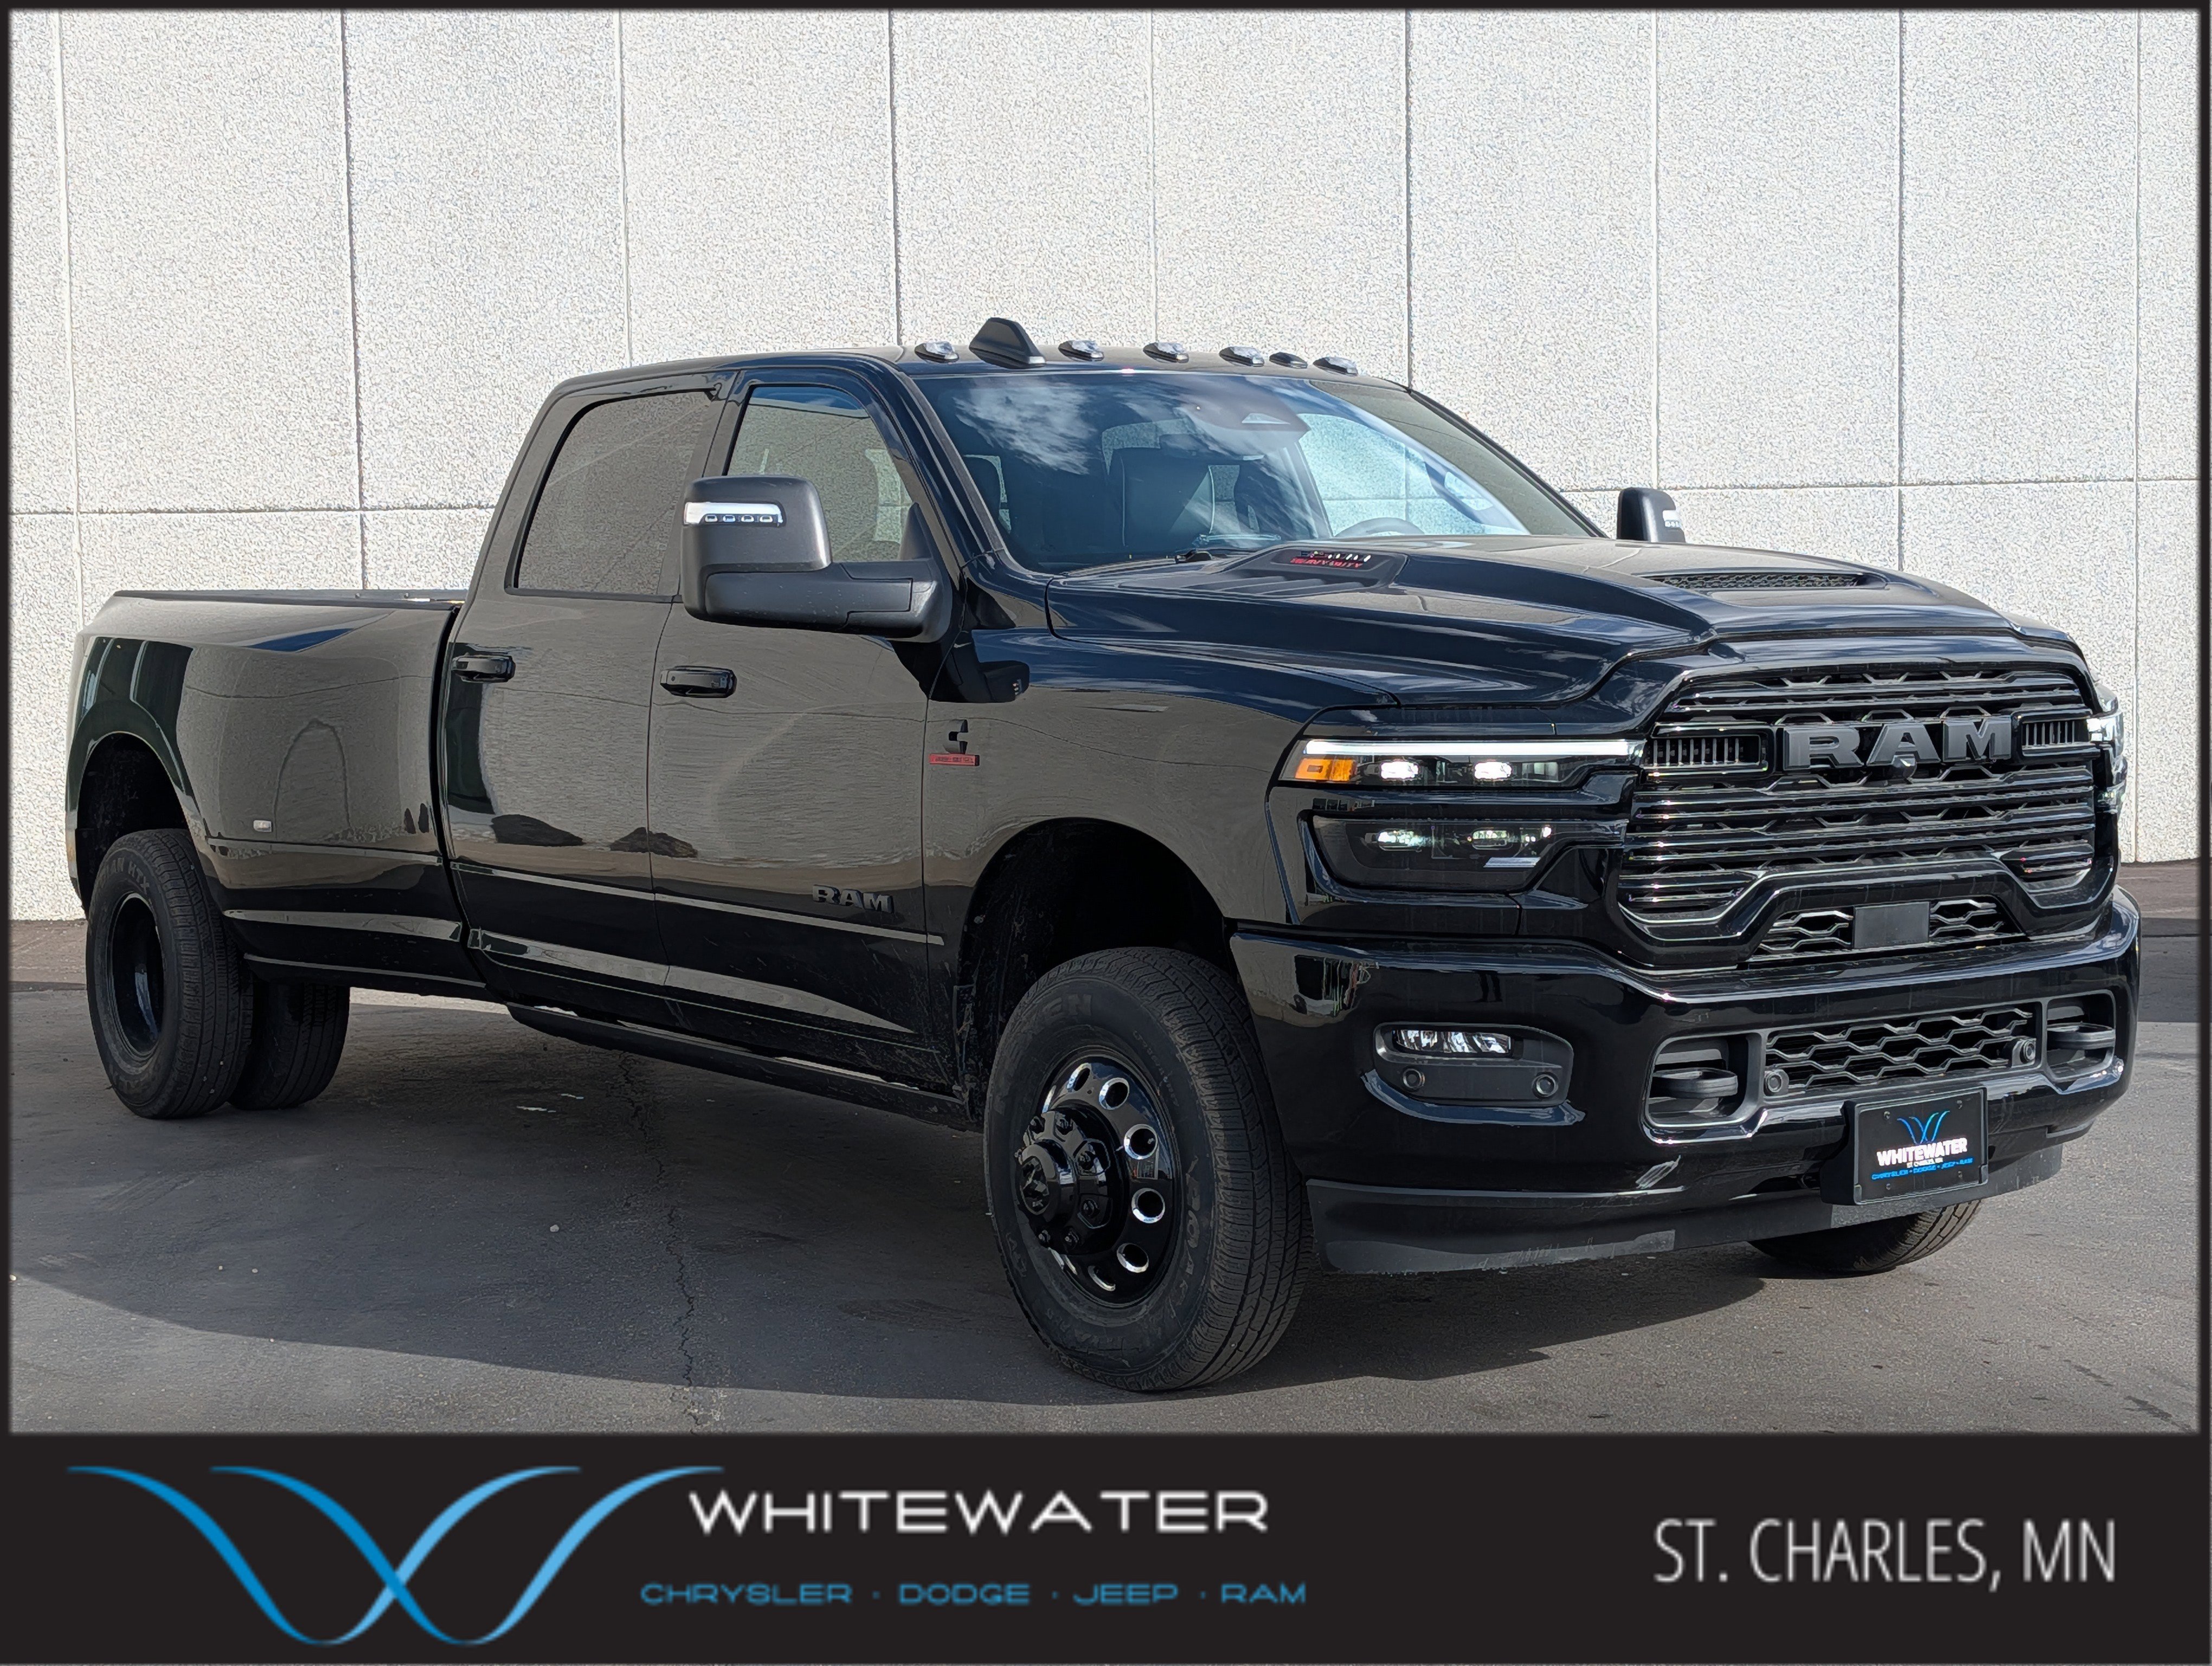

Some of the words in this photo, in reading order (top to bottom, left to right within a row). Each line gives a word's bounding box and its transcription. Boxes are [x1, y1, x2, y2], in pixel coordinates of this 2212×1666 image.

[1783, 714, 2011, 771] RAM
[813, 885, 895, 913] RAM
[1876, 1137, 1968, 1166] WHITEWATER
